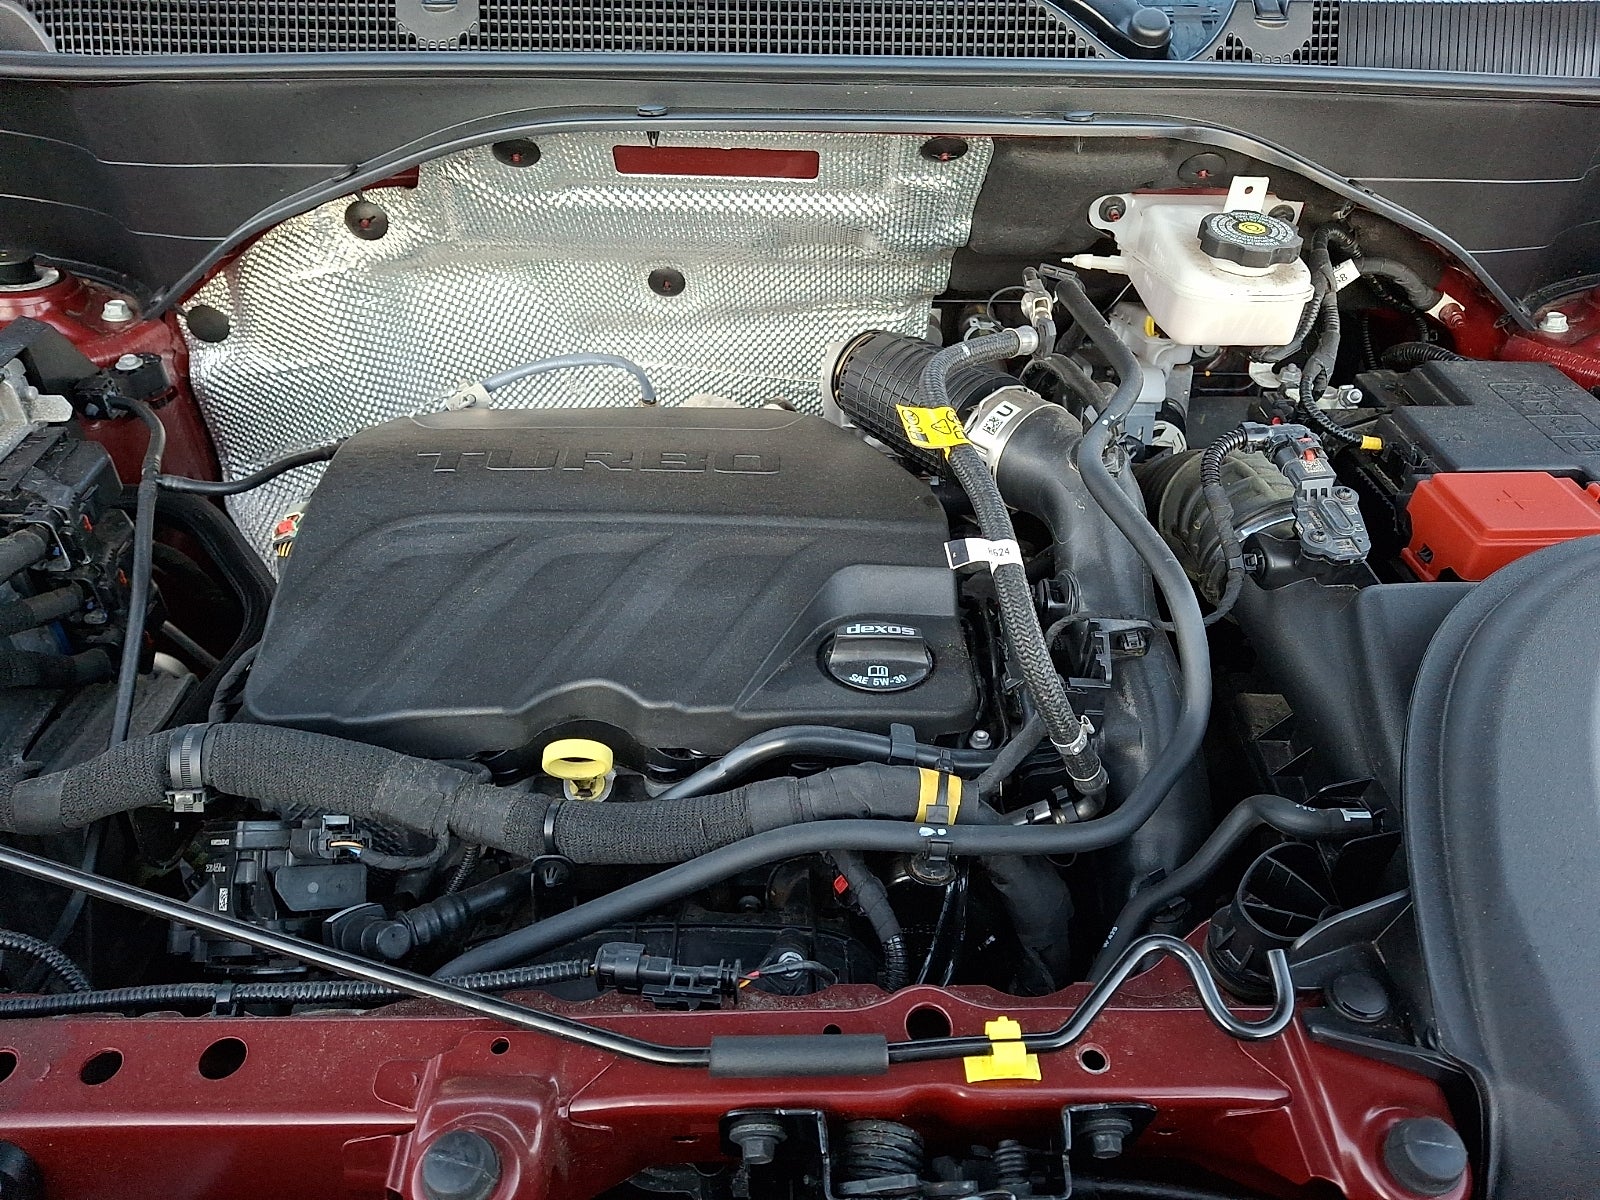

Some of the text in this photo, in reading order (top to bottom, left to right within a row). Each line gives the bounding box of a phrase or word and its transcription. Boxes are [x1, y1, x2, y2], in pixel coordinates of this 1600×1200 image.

[997, 404, 1014, 417] U
[416, 449, 781, 474] TURBO
[846, 623, 916, 636] dexos
[849, 673, 907, 686] SAE 5W-30
